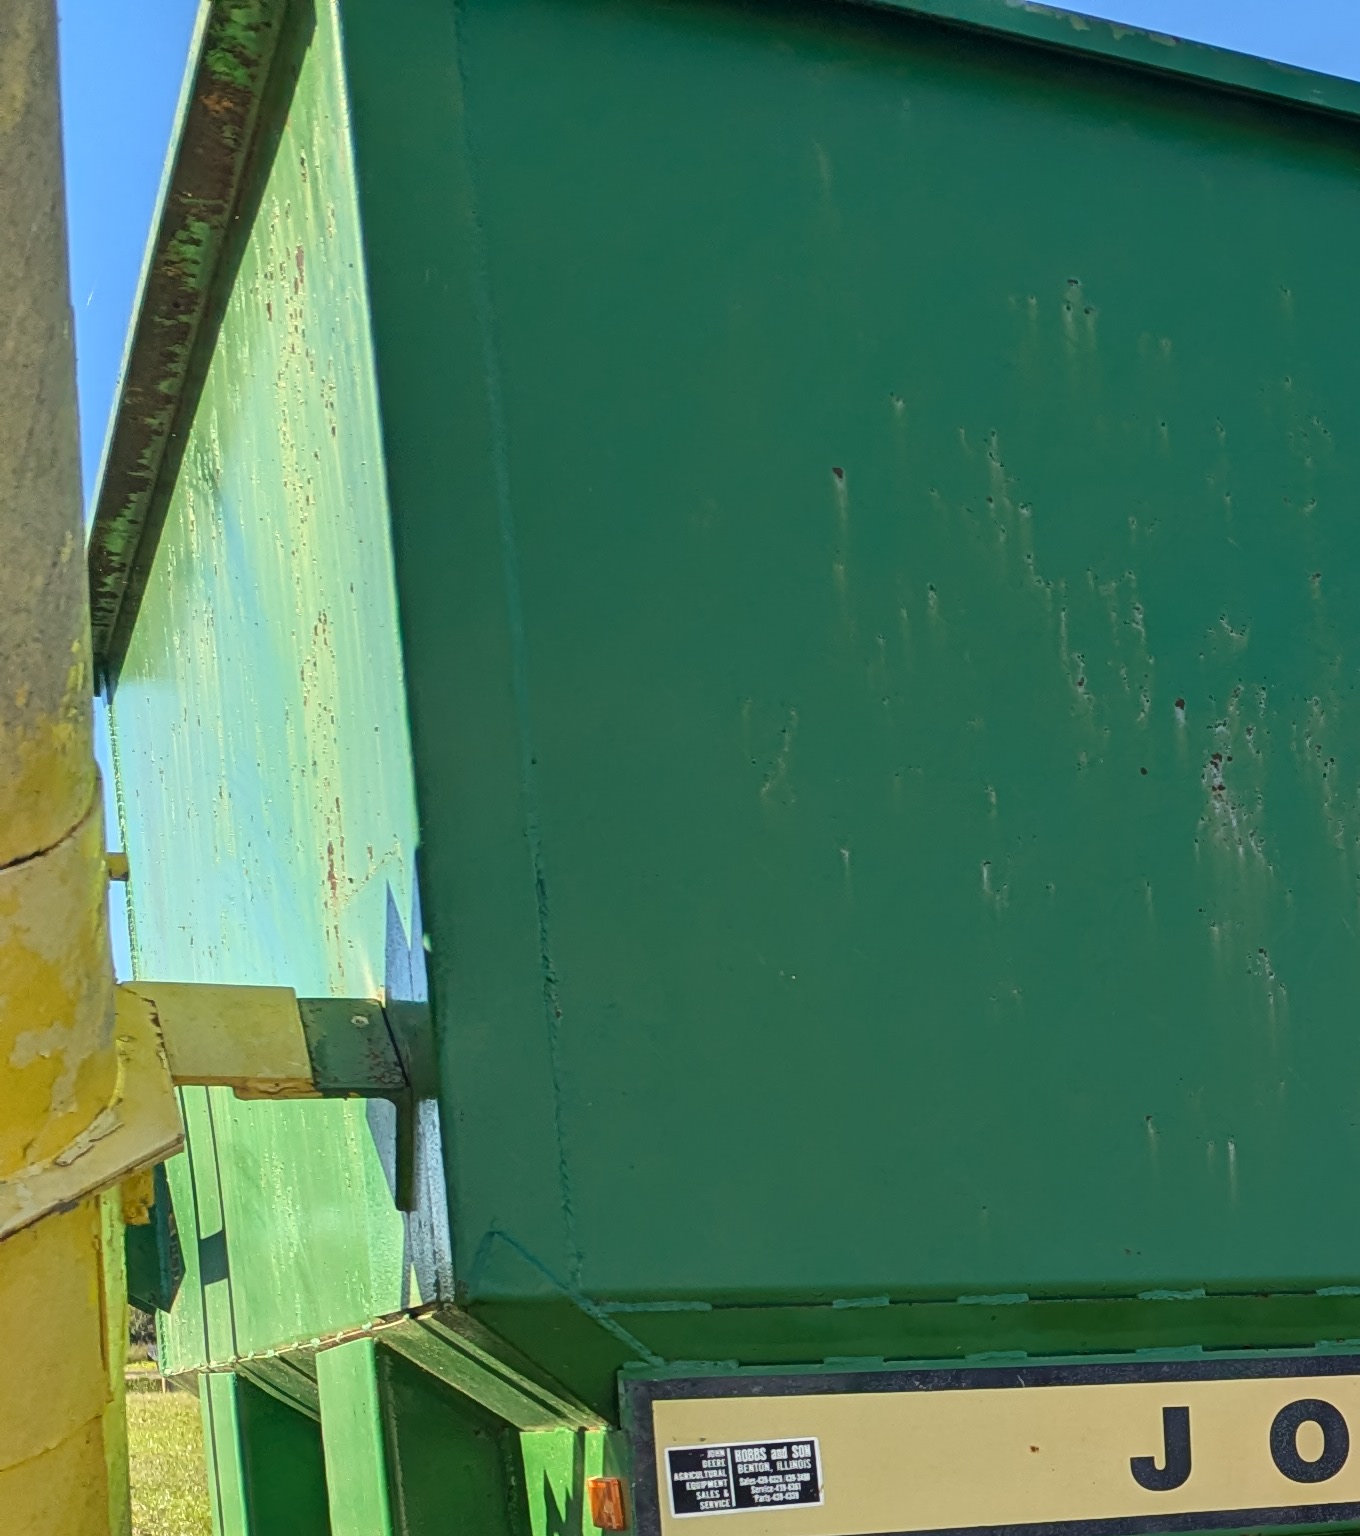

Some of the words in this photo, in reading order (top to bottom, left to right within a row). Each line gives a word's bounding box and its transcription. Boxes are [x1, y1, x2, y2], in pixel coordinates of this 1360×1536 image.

[706, 1449, 726, 1459] JOHN
[770, 1445, 789, 1460] and
[791, 1443, 812, 1459] SON
[701, 1458, 727, 1469] DEERE
[775, 1458, 812, 1472] ILLINOIS
[673, 1469, 728, 1482] AGRICULTURAL
[685, 1479, 728, 1491] EQUIPMENT
[695, 1489, 721, 1501] SALES
[699, 1498, 731, 1511] SERVICE
